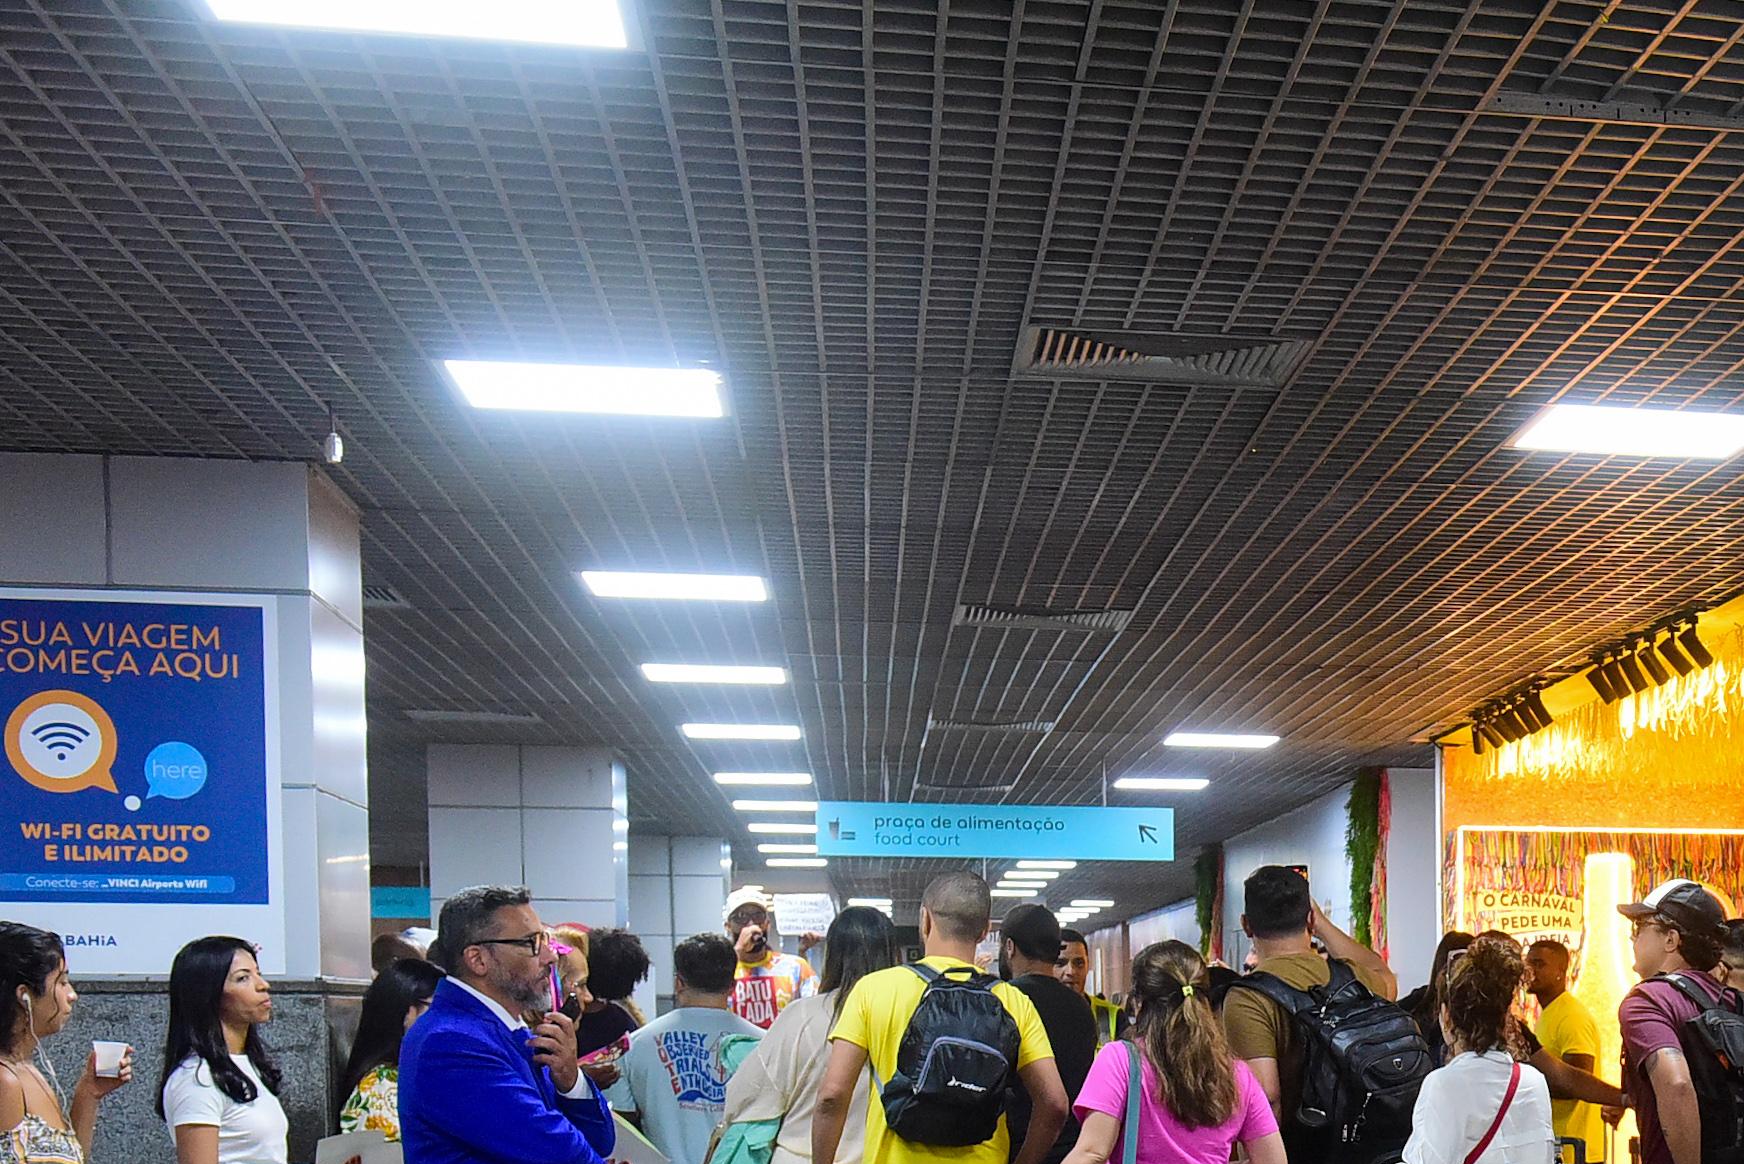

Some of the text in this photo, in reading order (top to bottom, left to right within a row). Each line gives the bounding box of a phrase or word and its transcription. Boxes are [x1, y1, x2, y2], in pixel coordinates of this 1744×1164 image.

[0, 620, 221, 650] SUA VIAGEM
[0, 648, 239, 683] OMEÇA AQUI
[152, 760, 200, 779] here
[20, 823, 210, 842] WI-FI GRATUITO
[874, 816, 1065, 834] praça de alimentação
[875, 832, 960, 846] food court
[44, 845, 188, 863] E ILIMITADO
[25, 876, 99, 889] Conecte-se:
[140, 879, 183, 890] Airports
[185, 879, 208, 889] Wifi
[1483, 893, 1575, 913] O CARNAVAL
[1501, 915, 1572, 930] PEDE UMA
[735, 979, 772, 1004] BATU
[736, 1001, 775, 1024] CADA
[653, 1030, 708, 1047] VALLEY
[664, 1057, 711, 1082] TRIALS
[671, 1074, 727, 1098] ENTHUSIA
